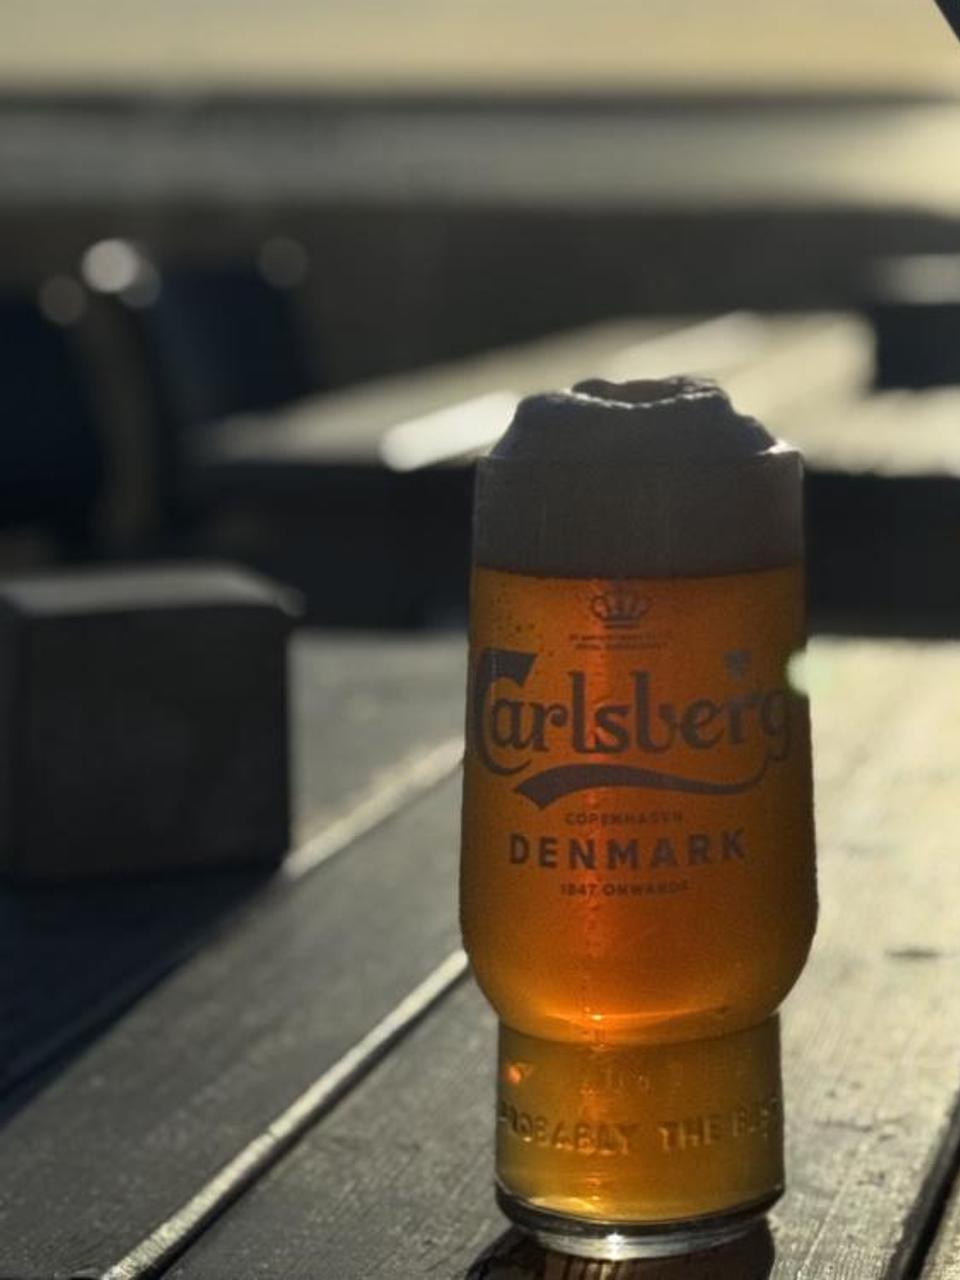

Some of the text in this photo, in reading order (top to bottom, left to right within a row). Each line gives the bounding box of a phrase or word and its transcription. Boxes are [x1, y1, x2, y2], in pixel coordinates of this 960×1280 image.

[472, 646, 794, 780] Carlsberg
[564, 810, 684, 826] COPENHAGEN
[509, 828, 747, 870] DENMARK
[560, 882, 598, 897] 1847
[656, 1117, 720, 1152] THE
